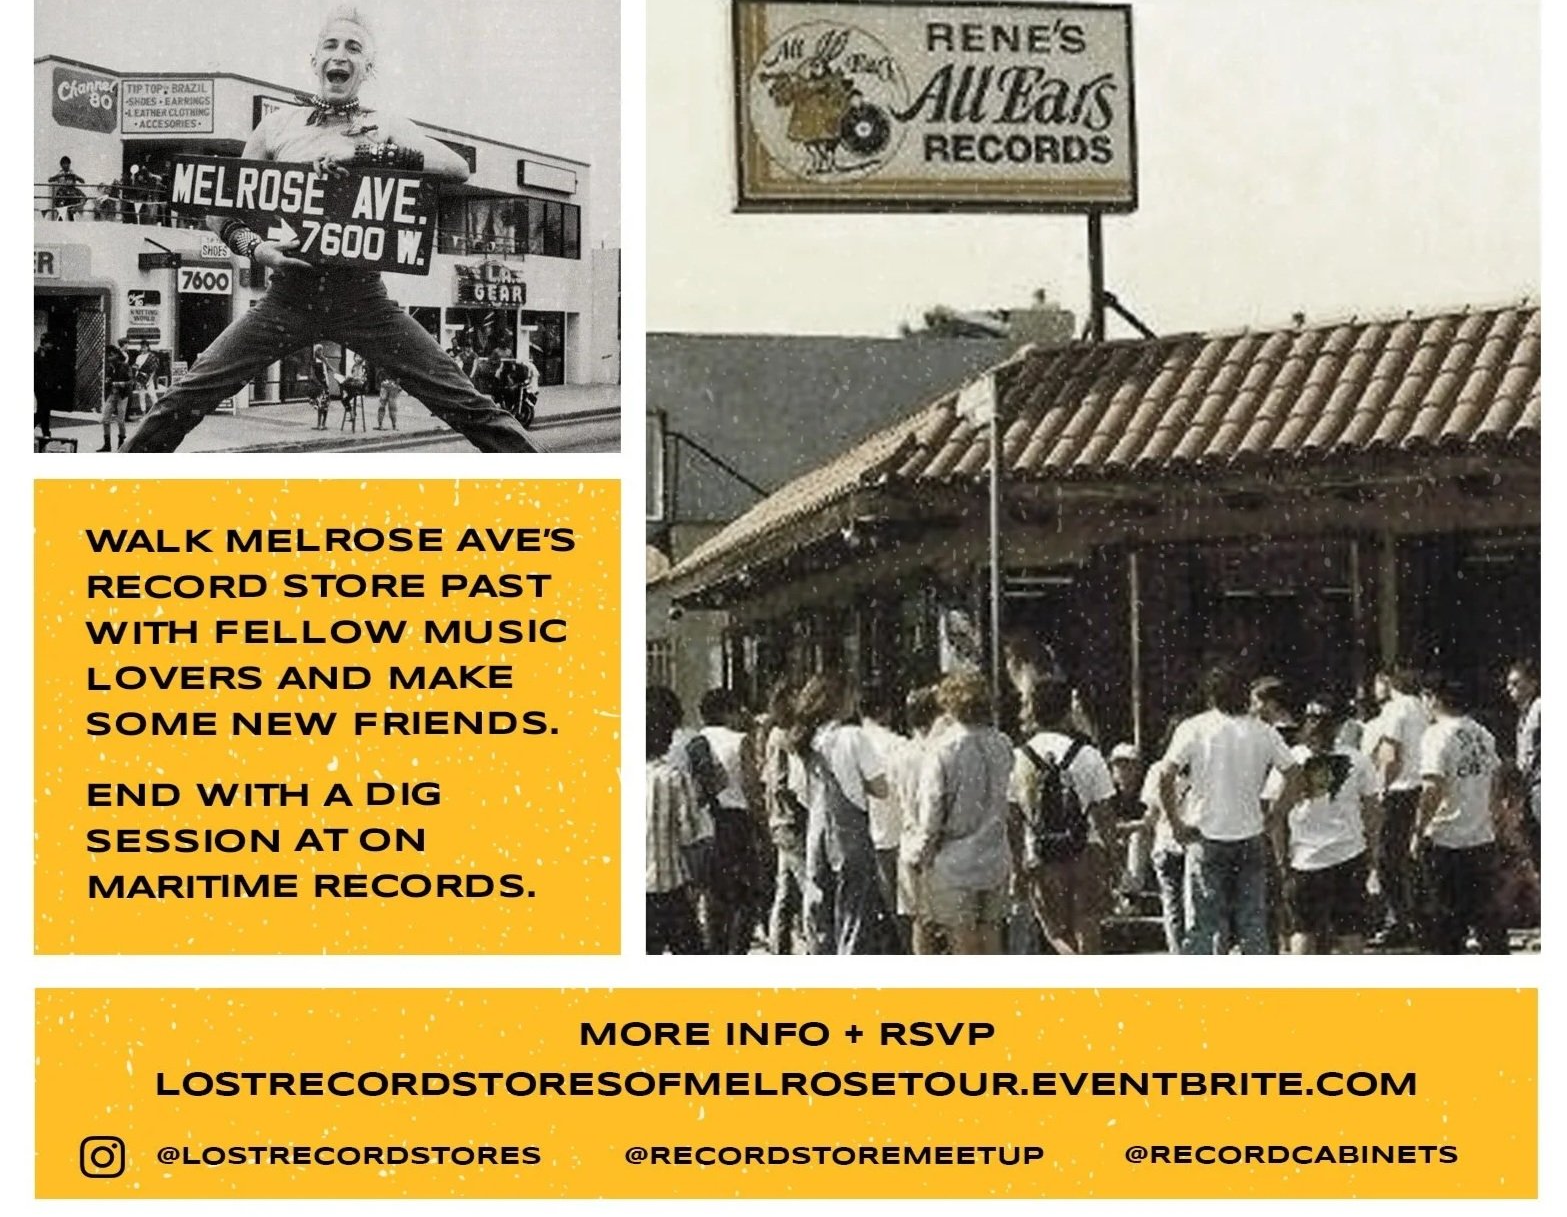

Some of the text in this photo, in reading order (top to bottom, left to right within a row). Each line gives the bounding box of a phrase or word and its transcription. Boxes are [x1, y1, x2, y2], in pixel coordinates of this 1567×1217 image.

[927, 19, 1086, 54] RENE'S
[58, 80, 118, 101] Channel
[90, 92, 113, 110] 80
[127, 84, 142, 94] TIP
[144, 84, 162, 94] TOP
[171, 83, 208, 93] BRAZIL
[165, 97, 211, 106] EARRINGS
[890, 63, 1118, 131] All Ears
[169, 108, 210, 117] CLOTHING
[924, 134, 1113, 164] RECORDS
[172, 163, 427, 225] MELROSE AVE.
[300, 220, 424, 266] 7600 W.
[182, 271, 230, 291] 7600
[474, 283, 522, 302] GEAR
[86, 527, 575, 553] WALK MELROSE AVE'S
[88, 573, 552, 599] RECORD STORE PAST
[86, 618, 567, 645] WITH FELLOW MUSIC
[88, 665, 513, 691] LOVERS AND MAKE
[86, 710, 558, 736] SOME NEW FRIENDS.
[88, 782, 440, 807] END WITH A DIG
[87, 828, 425, 853] SESSION AT ON
[89, 873, 535, 899] MARITIME RECORDS.
[581, 1021, 710, 1047] MORE
[727, 1021, 830, 1047] INFO
[881, 1021, 995, 1047] RSVP
[157, 1071, 1416, 1097] LOSTRECORDSTORESOFMELROSETOUR.EVENTBRITE.COM
[157, 1145, 1458, 1166] @LOSTRECORDSTORES @RECORDSTOREMEETUP @RECORDCABINETS
